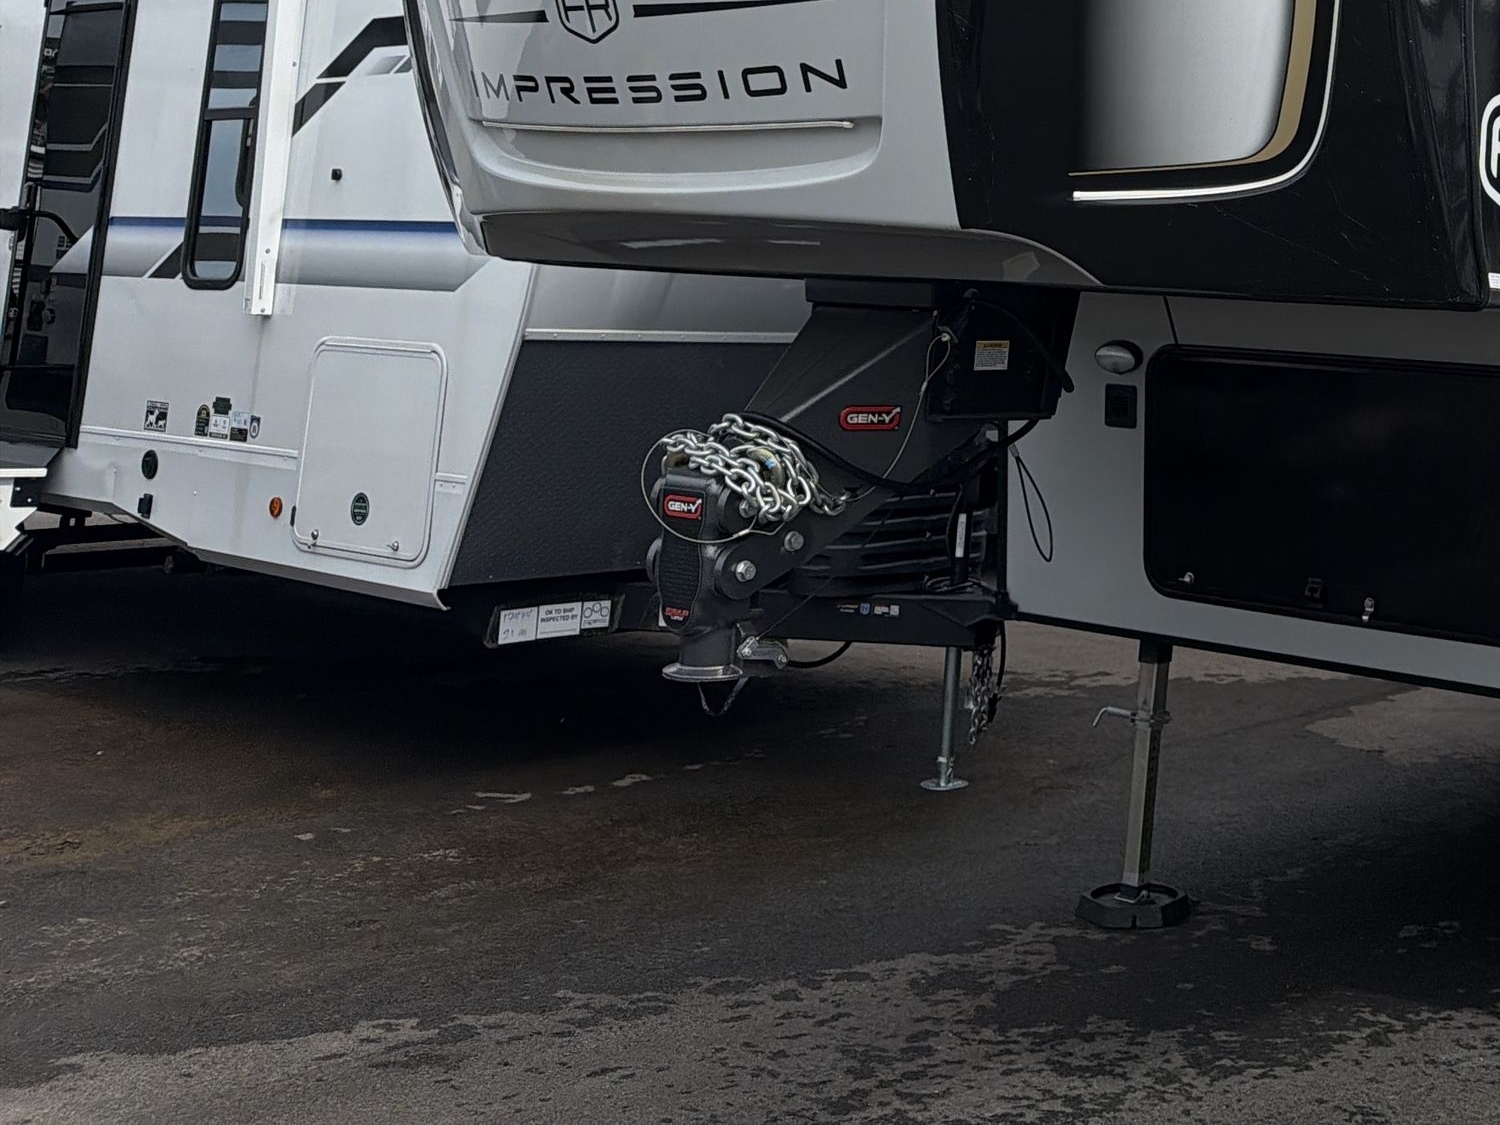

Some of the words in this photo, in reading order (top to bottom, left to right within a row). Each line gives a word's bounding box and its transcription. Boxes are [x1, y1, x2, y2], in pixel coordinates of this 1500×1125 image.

[470, 58, 848, 105] IMPRESSION
[846, 406, 901, 424] GEN-Y
[667, 498, 702, 513] GEN-Y
